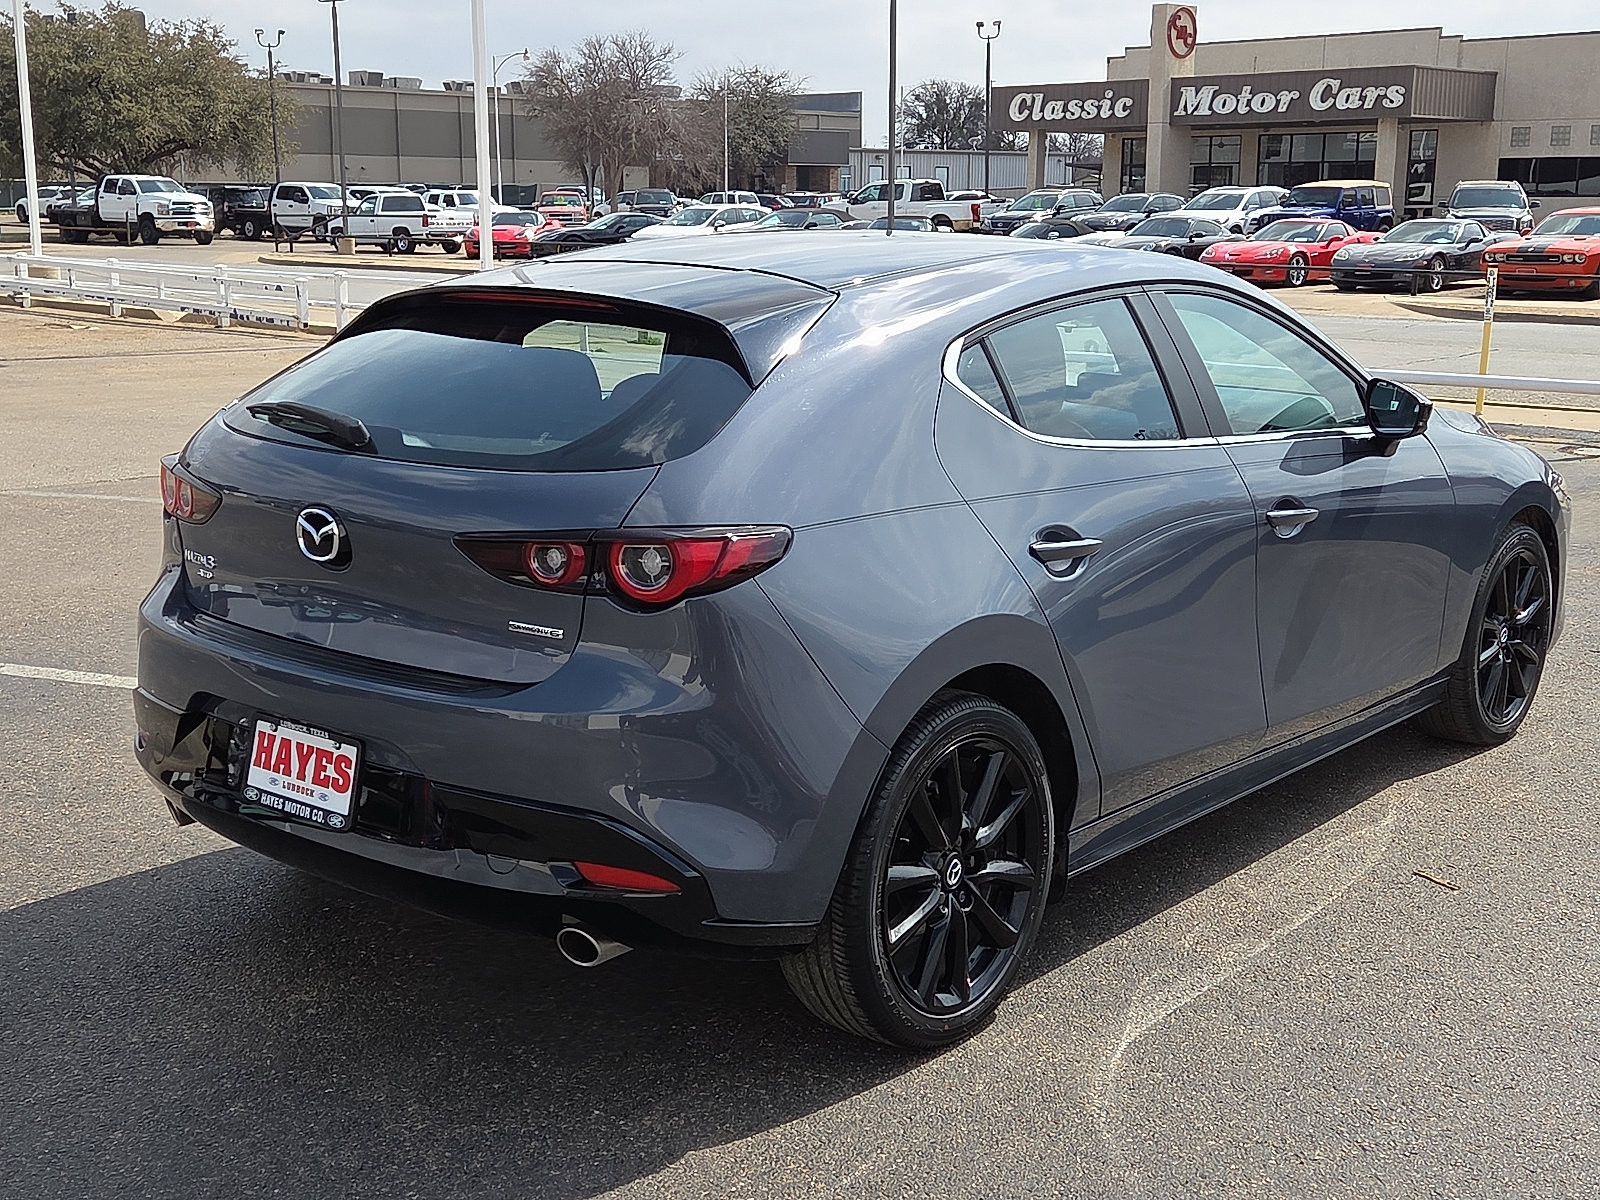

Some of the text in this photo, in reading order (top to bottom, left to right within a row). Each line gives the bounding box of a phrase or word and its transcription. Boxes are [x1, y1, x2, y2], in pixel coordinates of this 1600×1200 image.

[1008, 78, 1406, 122] Classic Motor Cars
[252, 730, 353, 794] HAYES
[260, 792, 325, 824] HAYES MOTOR CO.
[282, 780, 316, 798] LUBBOCK
